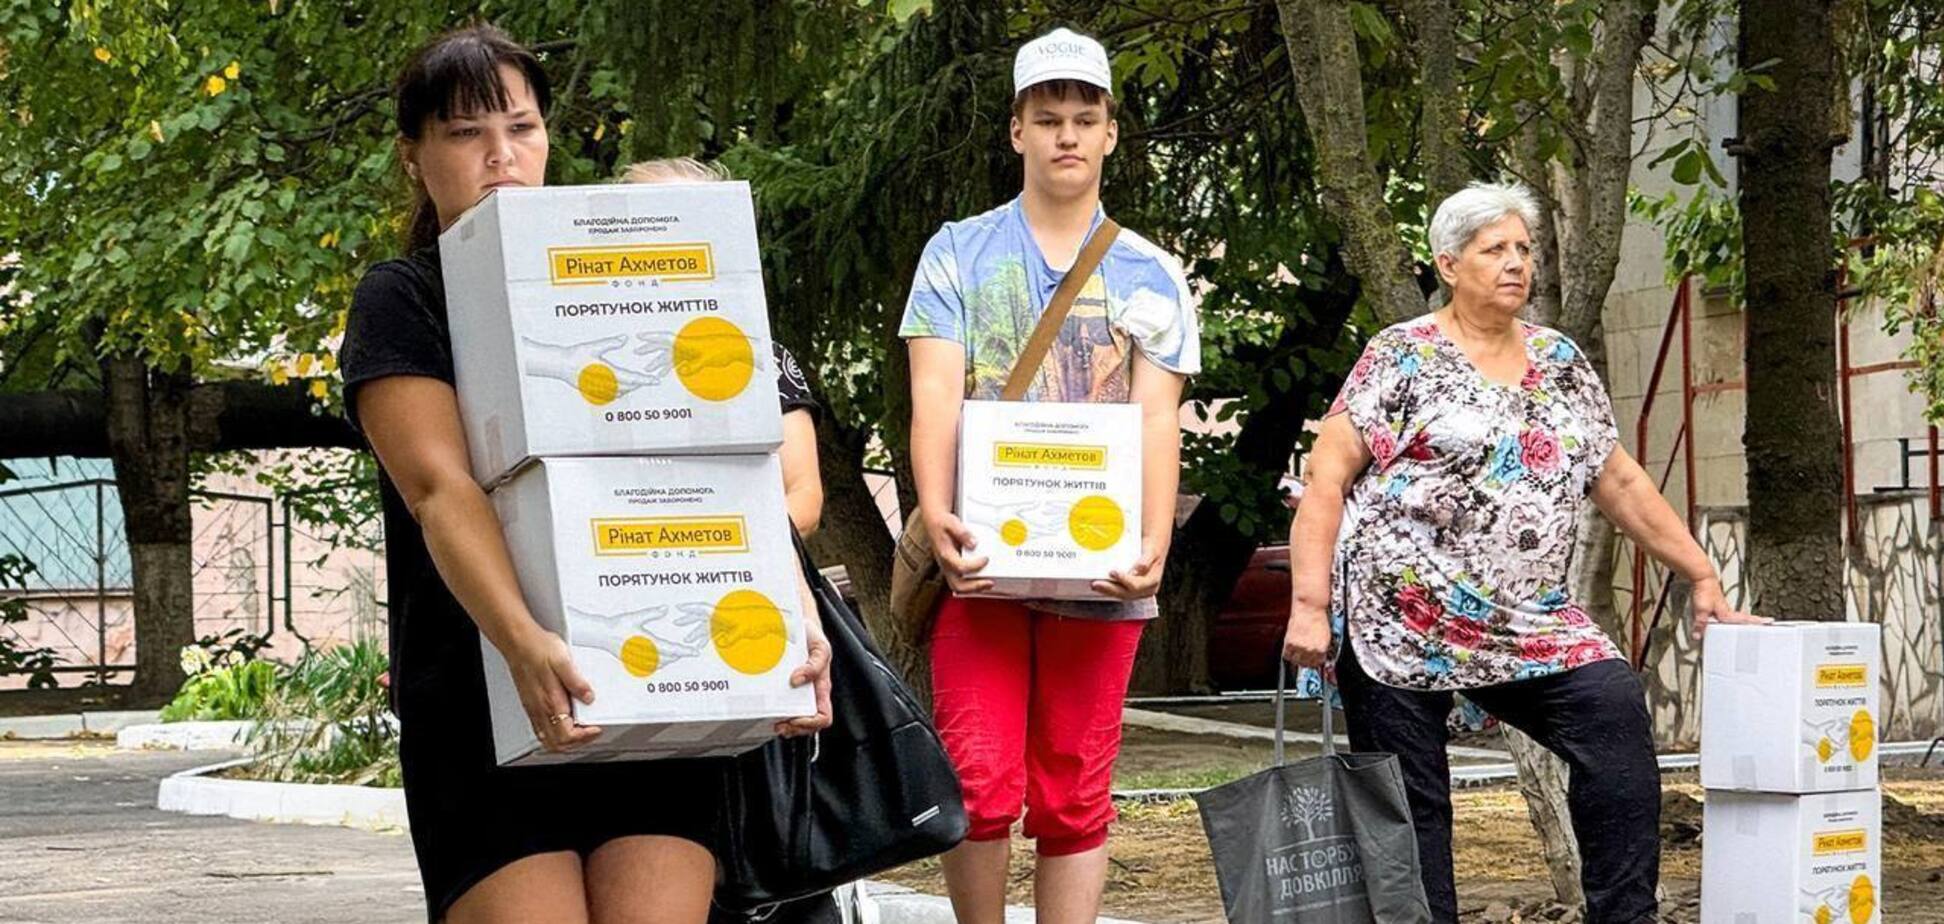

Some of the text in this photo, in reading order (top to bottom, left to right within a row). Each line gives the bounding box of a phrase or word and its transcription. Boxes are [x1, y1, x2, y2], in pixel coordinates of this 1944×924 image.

[1034, 42, 1086, 56] VOGUE
[631, 216, 680, 225] ДОПОМОГА
[566, 256, 697, 274] Рінат Ахметов
[555, 299, 718, 317] ПОРЯТУНОК ЖИТТІВ
[605, 408, 692, 422] 0 800 50 9001
[1041, 449, 1096, 462] Ахметов
[668, 487, 715, 495] ДОПОМОГА
[993, 477, 1106, 491] ПОРЯТУНОК ЖИТТІВ
[608, 527, 732, 544] Рінат Ахметов
[598, 570, 753, 587] ПОРЯТУНОК ЖИТТІВ
[647, 680, 729, 693] 0 800 50 9001
[1265, 854, 1298, 876] НАС
[1280, 864, 1362, 900] ДОВКІЛЛЯ
